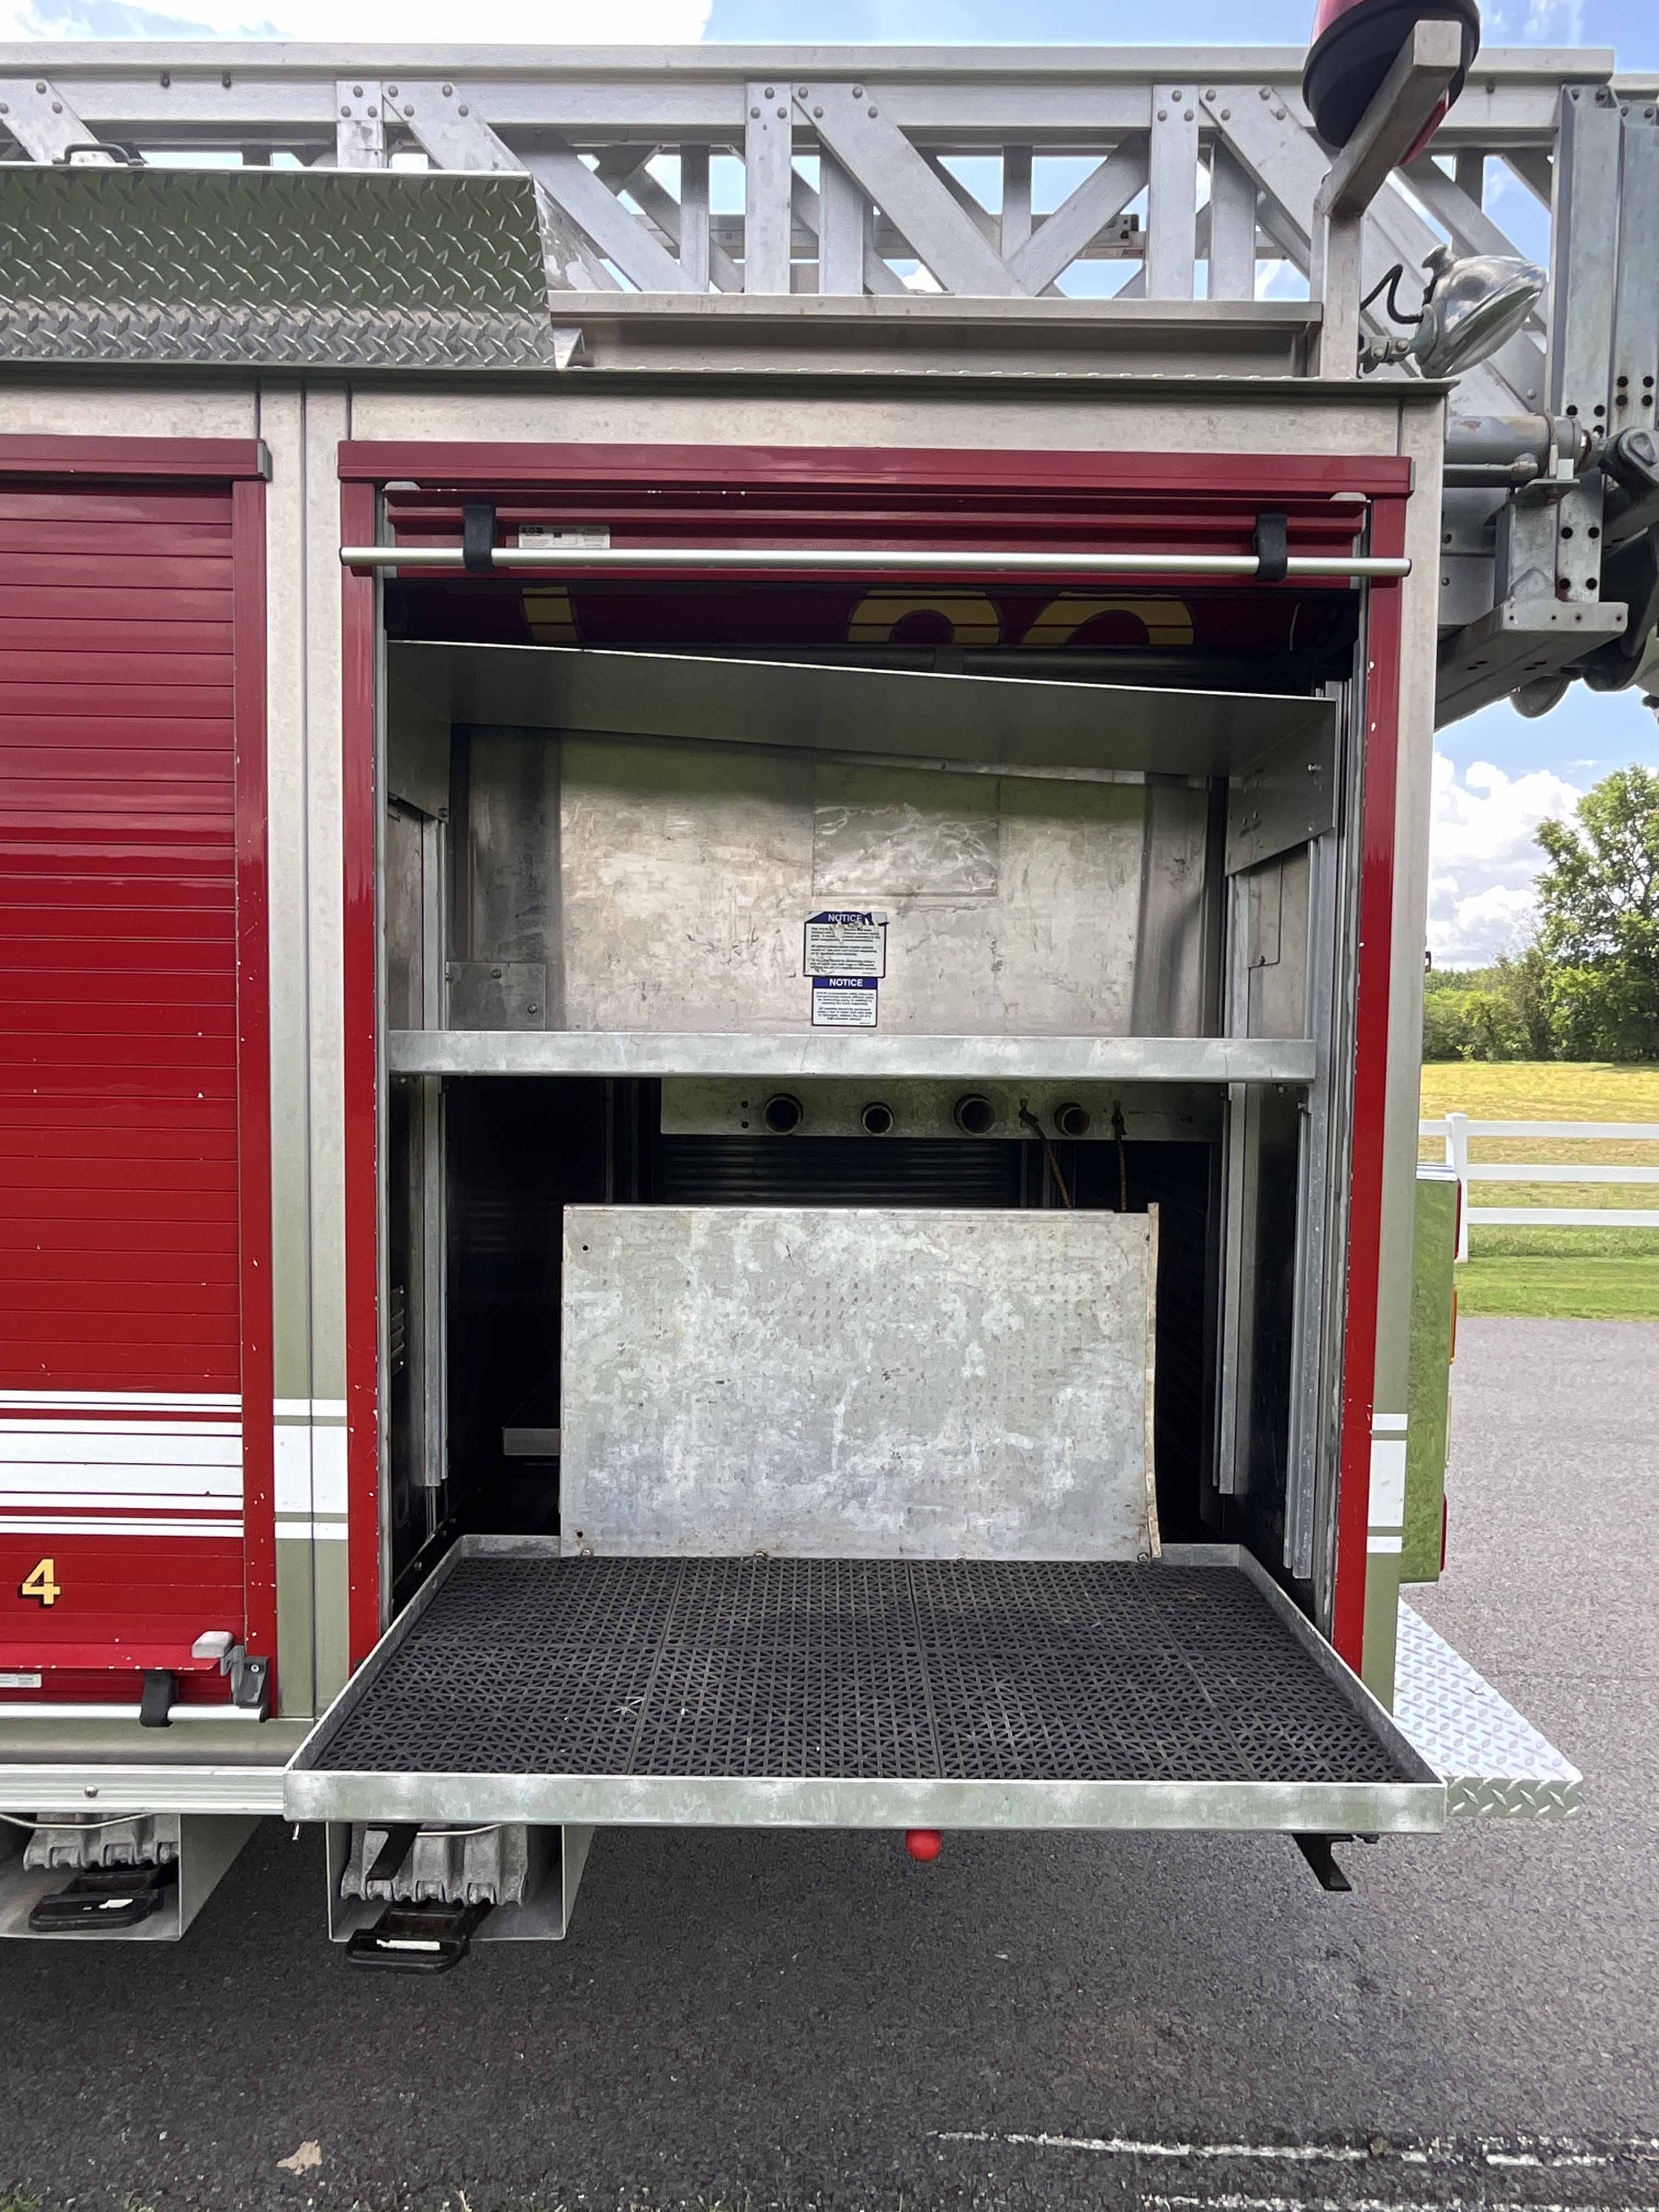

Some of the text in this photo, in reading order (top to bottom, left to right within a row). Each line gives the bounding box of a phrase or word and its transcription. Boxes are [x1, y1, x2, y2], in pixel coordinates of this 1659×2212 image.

[828, 914, 862, 922] NOTICE
[829, 978, 864, 986] NOTICE
[21, 1558, 61, 1605] 4
